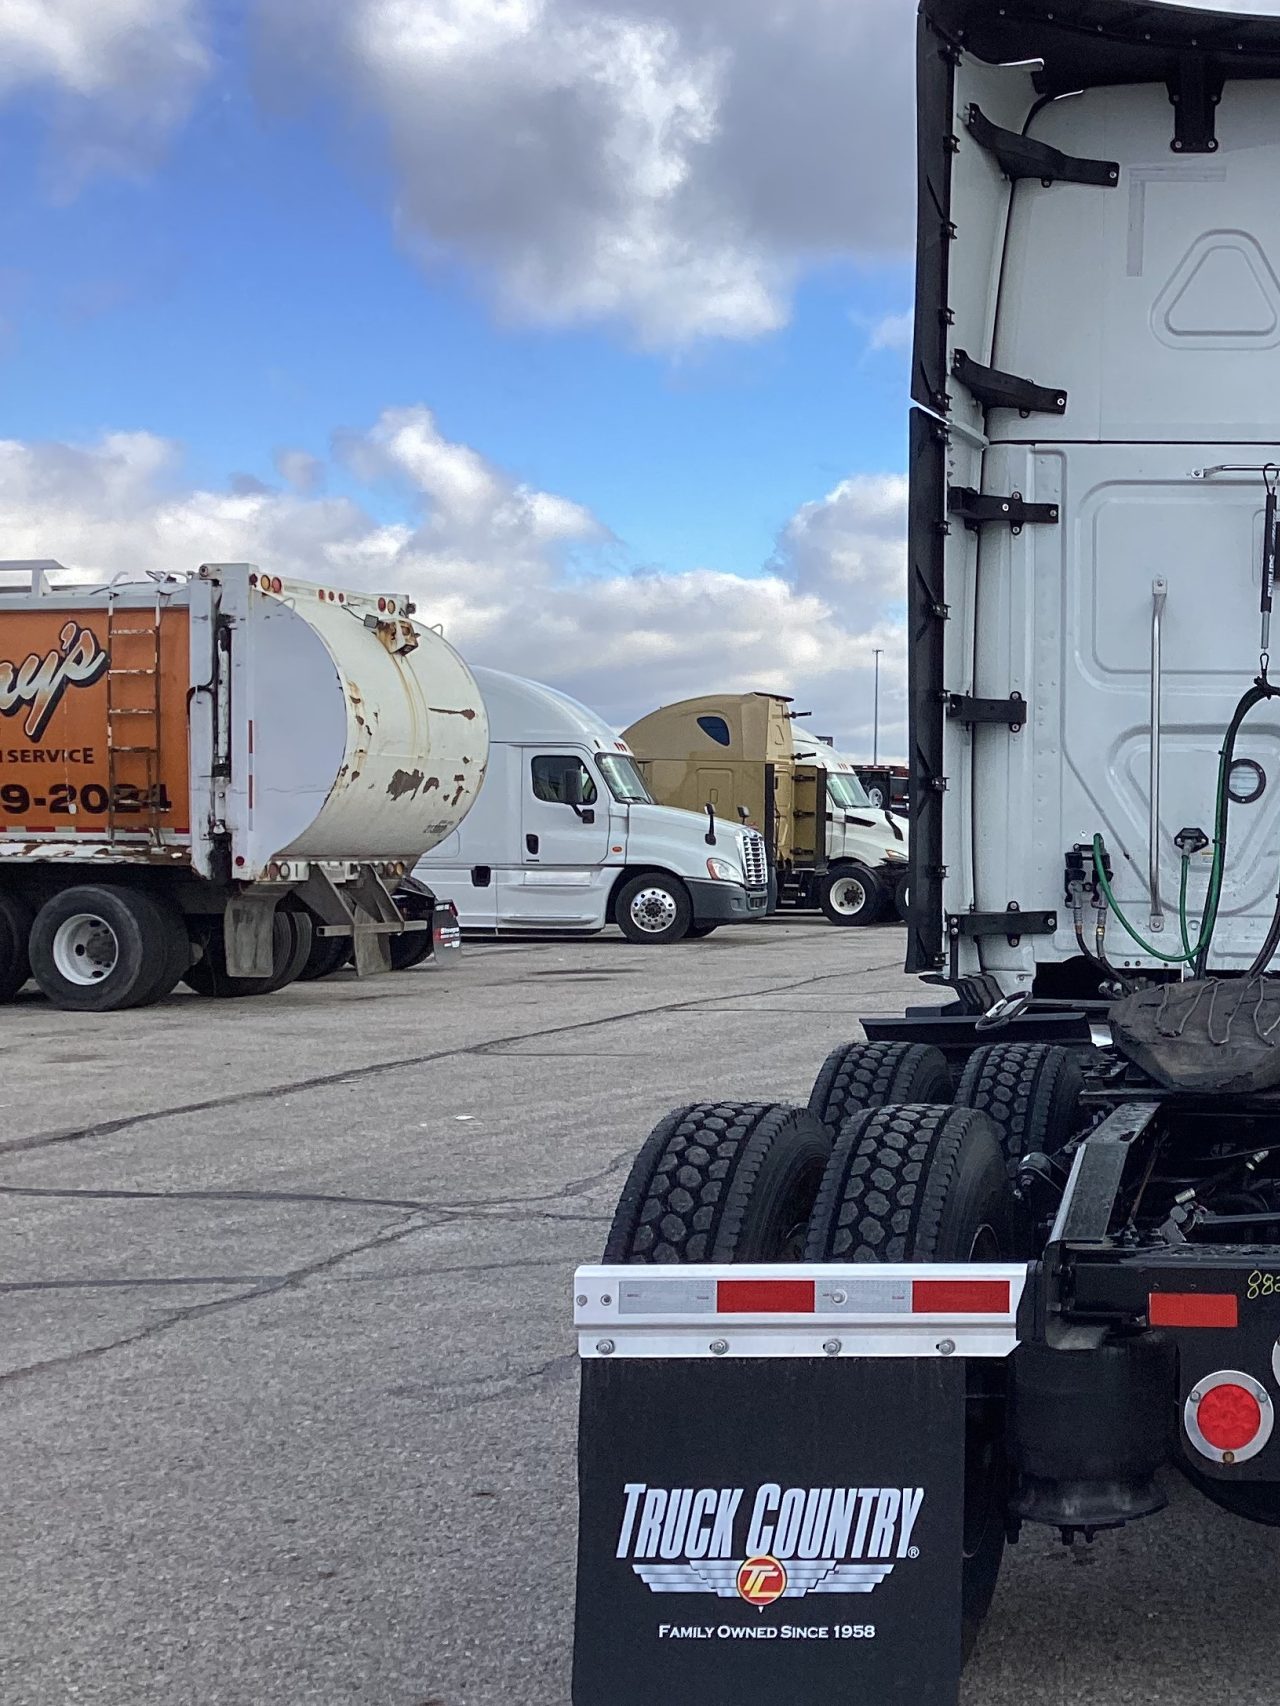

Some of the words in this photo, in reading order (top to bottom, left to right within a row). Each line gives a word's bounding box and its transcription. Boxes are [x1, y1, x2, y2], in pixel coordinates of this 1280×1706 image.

[7, 748, 95, 764] SERVICE
[615, 1483, 744, 1559] TRUCK
[658, 1624, 715, 1639] FAMILY
[717, 1625, 778, 1639] OWNED
[780, 1625, 829, 1639] SINCE
[834, 1625, 876, 1639] 1958
